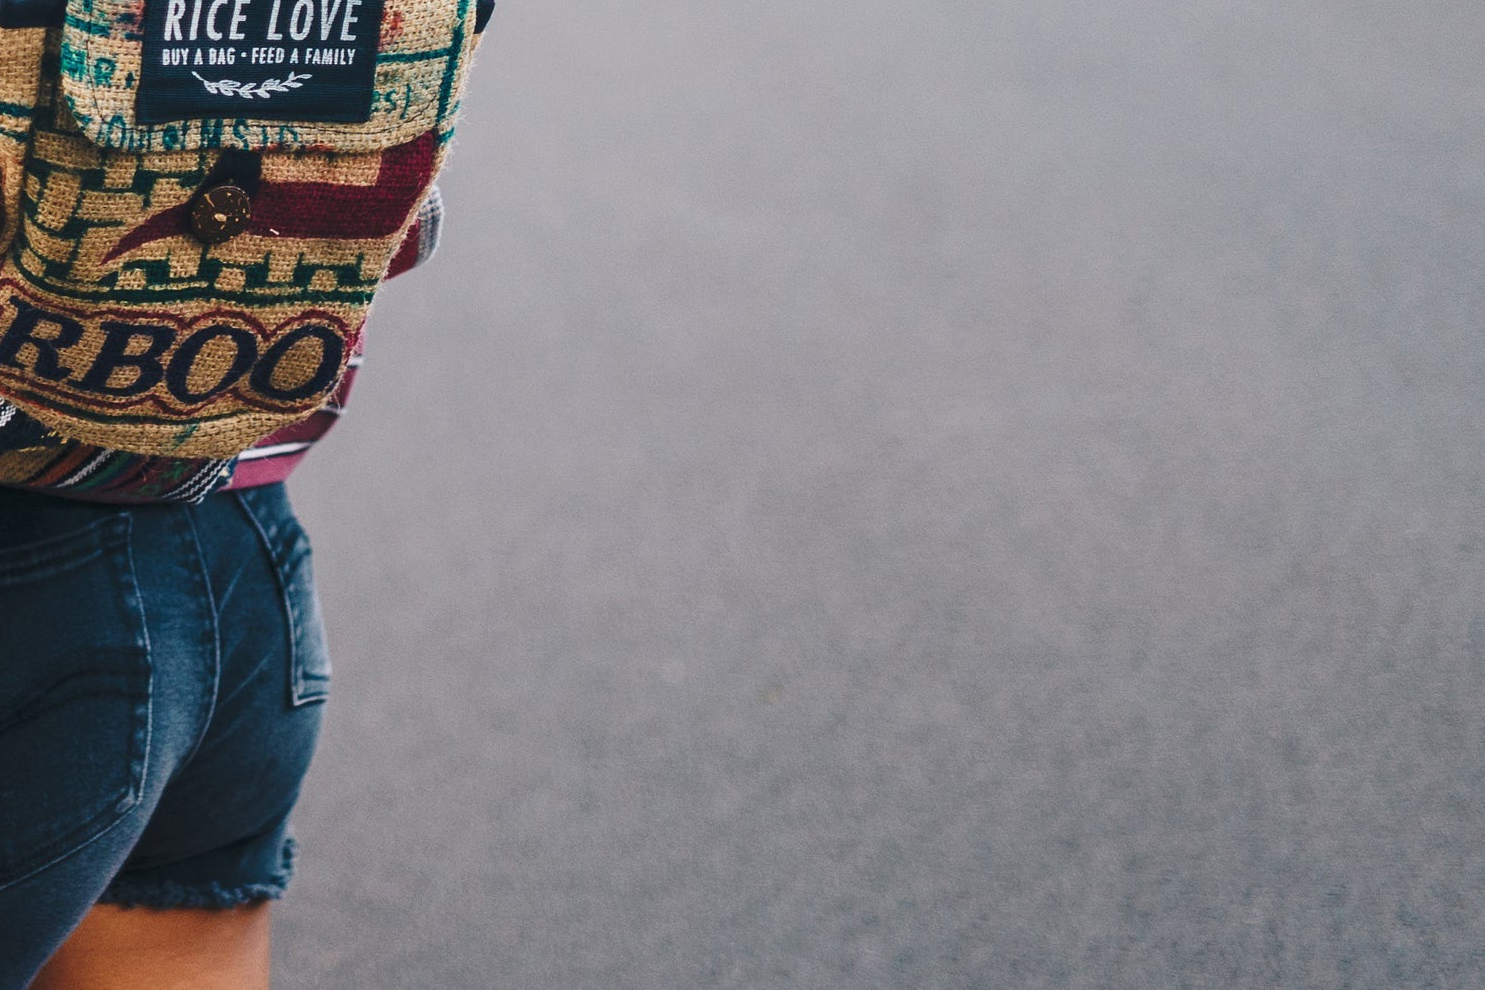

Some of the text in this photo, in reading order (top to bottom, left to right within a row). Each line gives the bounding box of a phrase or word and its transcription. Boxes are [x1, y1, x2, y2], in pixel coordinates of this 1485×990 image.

[161, 47, 356, 66] BUY A BAG FEED A FAMILY
